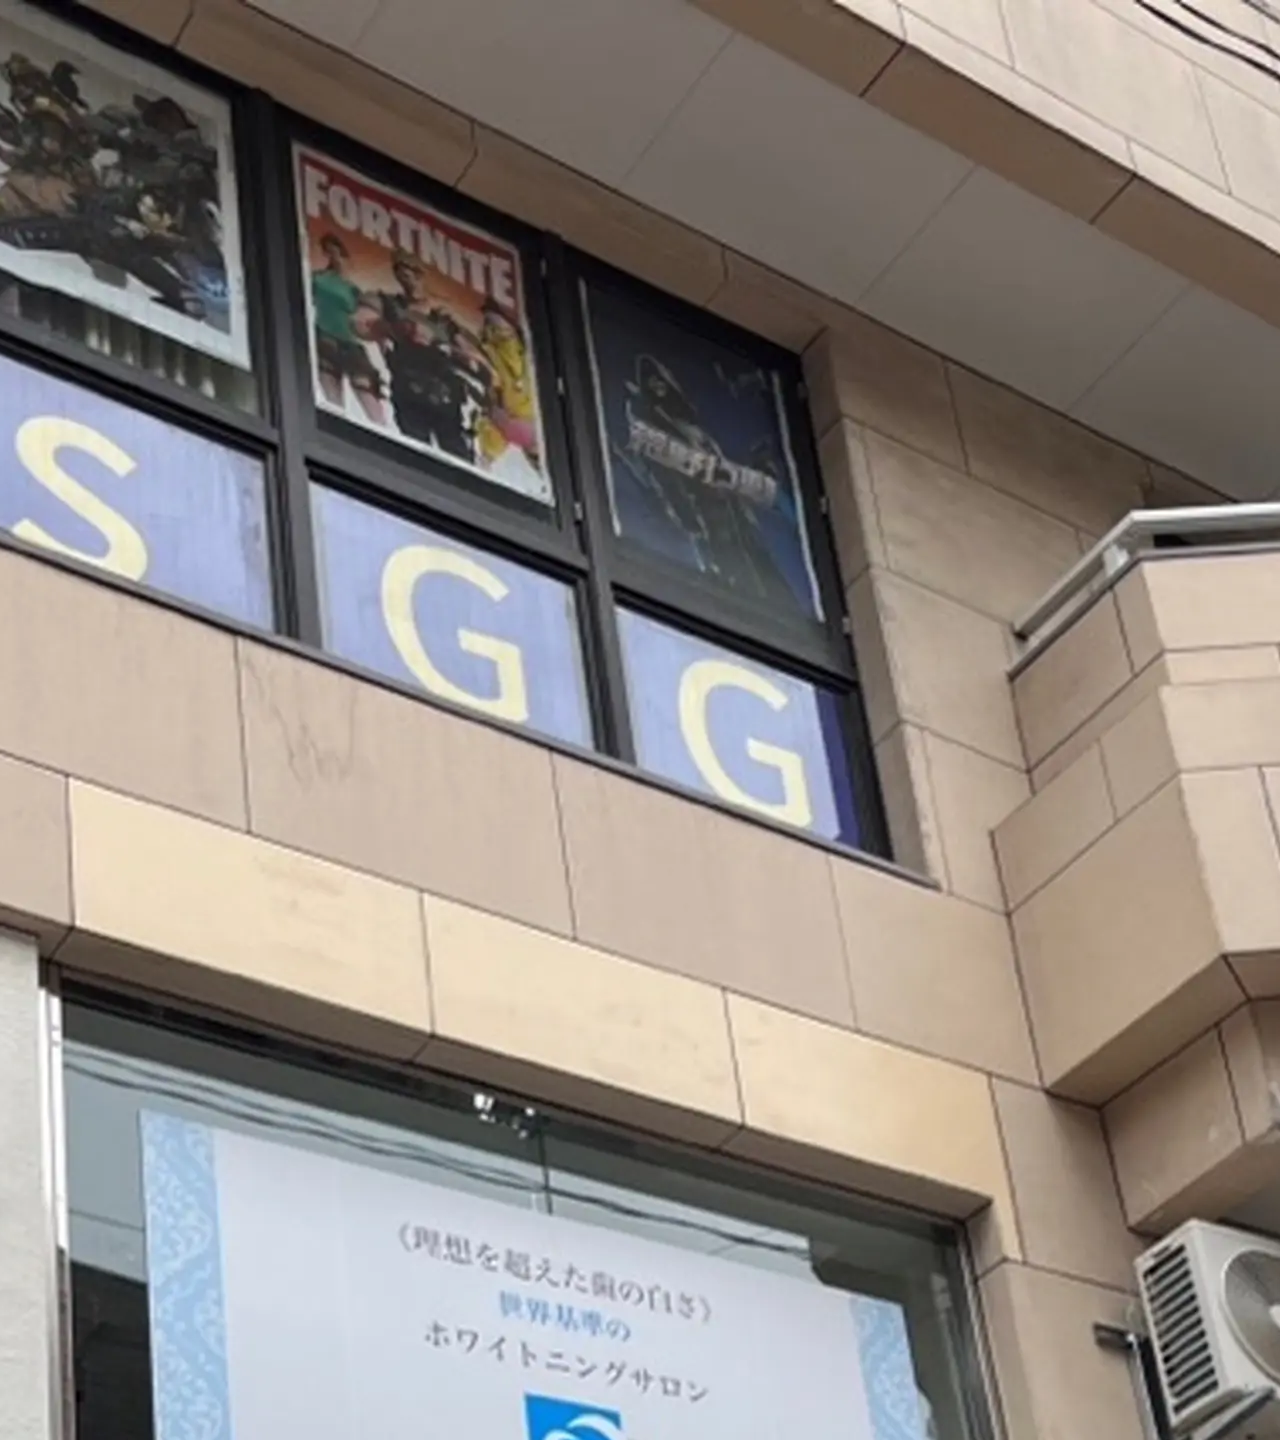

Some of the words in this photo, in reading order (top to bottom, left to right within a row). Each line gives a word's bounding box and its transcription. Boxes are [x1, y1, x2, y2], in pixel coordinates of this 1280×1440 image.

[301, 165, 516, 310] FORTNITE
[499, 1290, 632, 1344] 世界基準の
[425, 1320, 709, 1403] ホワイトニングサロン
